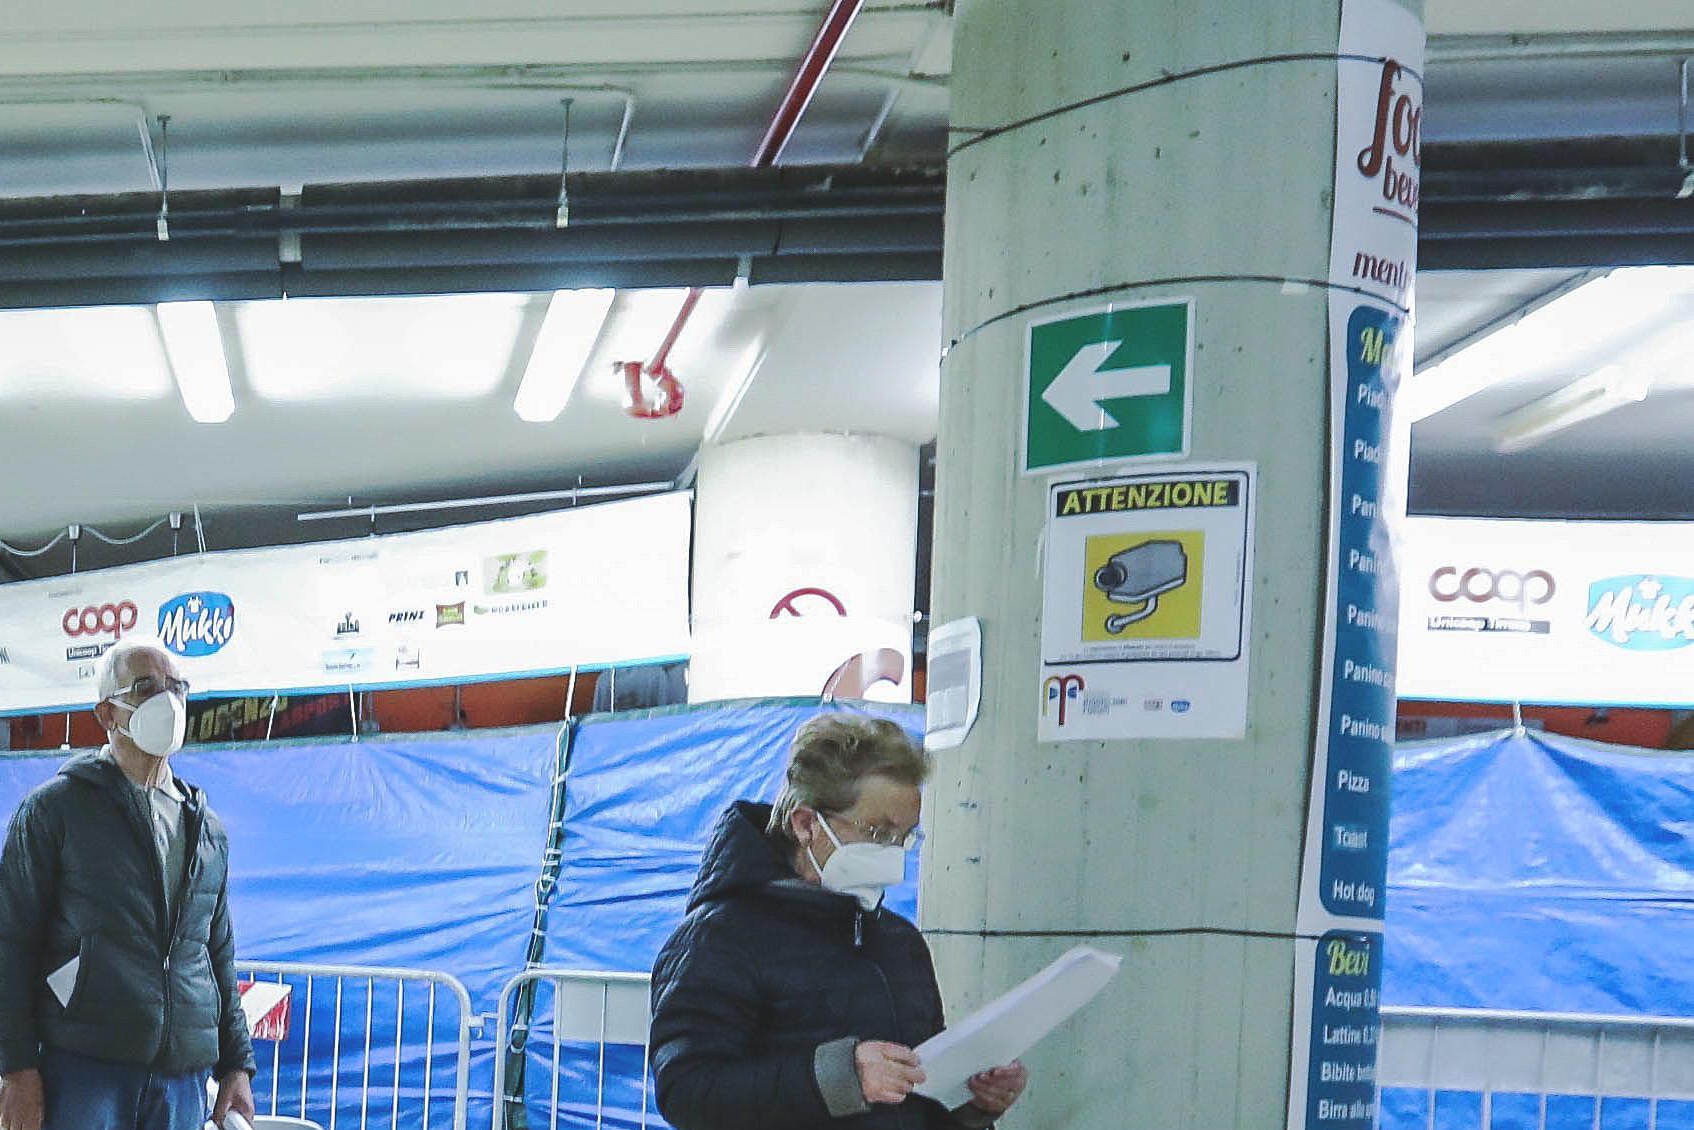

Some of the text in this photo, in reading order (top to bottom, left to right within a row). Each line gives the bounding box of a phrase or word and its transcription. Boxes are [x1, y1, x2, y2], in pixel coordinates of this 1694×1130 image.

[1062, 481, 1230, 515] ATTENZIONE
[1428, 566, 1555, 614] coop
[63, 600, 138, 640] coop
[156, 604, 234, 652] Mukki
[1337, 768, 1370, 793] Pizza
[1333, 825, 1369, 849] Toast
[1333, 878, 1376, 907] Hot dog
[1326, 939, 1370, 976] Bevi
[1325, 986, 1362, 1011] Acqua
[1320, 1061, 1355, 1082] Bibite
[1318, 1098, 1348, 1120] Birra
